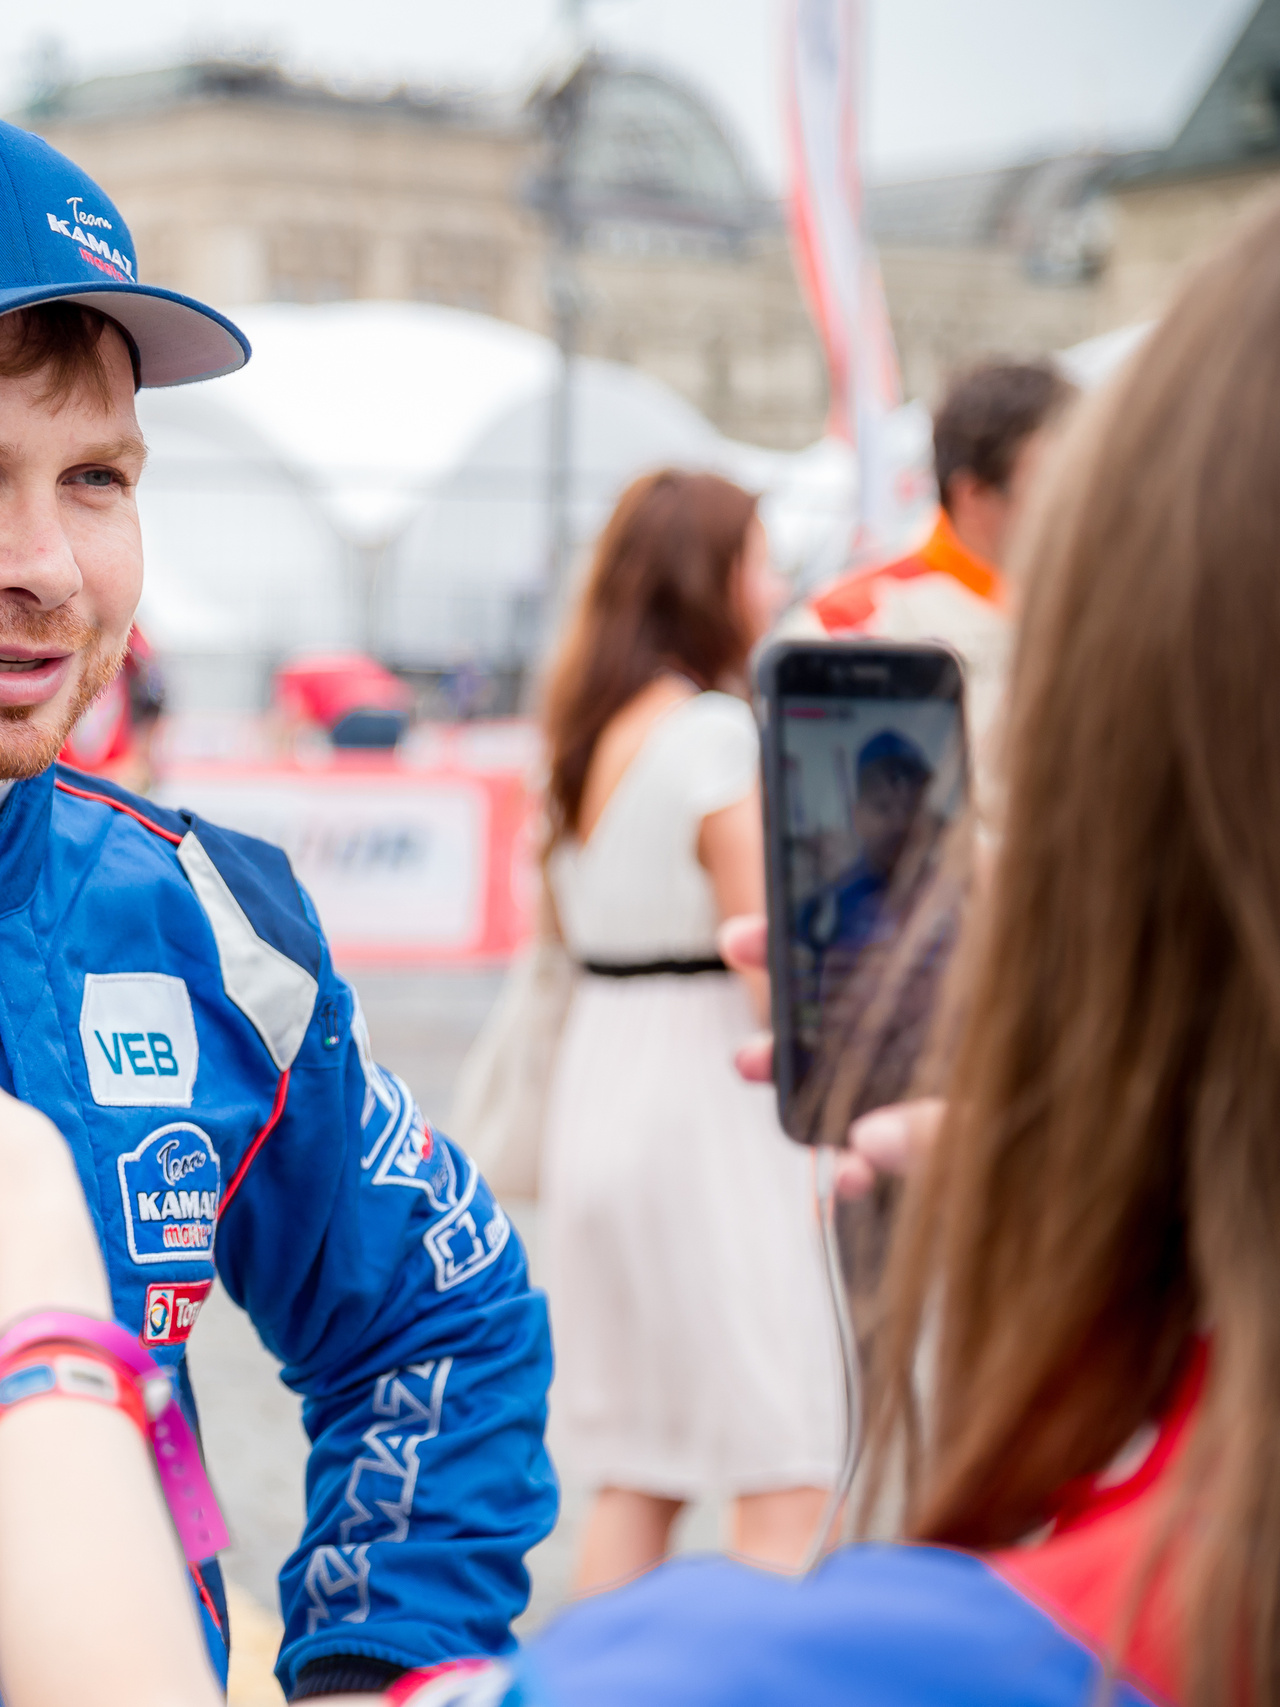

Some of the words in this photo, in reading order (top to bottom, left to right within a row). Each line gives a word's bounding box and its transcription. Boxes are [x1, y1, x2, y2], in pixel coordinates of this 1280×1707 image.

[66, 196, 112, 230] Team
[78, 246, 129, 283] maste
[94, 1030, 179, 1076] VEB
[157, 1139, 207, 1187] Team
